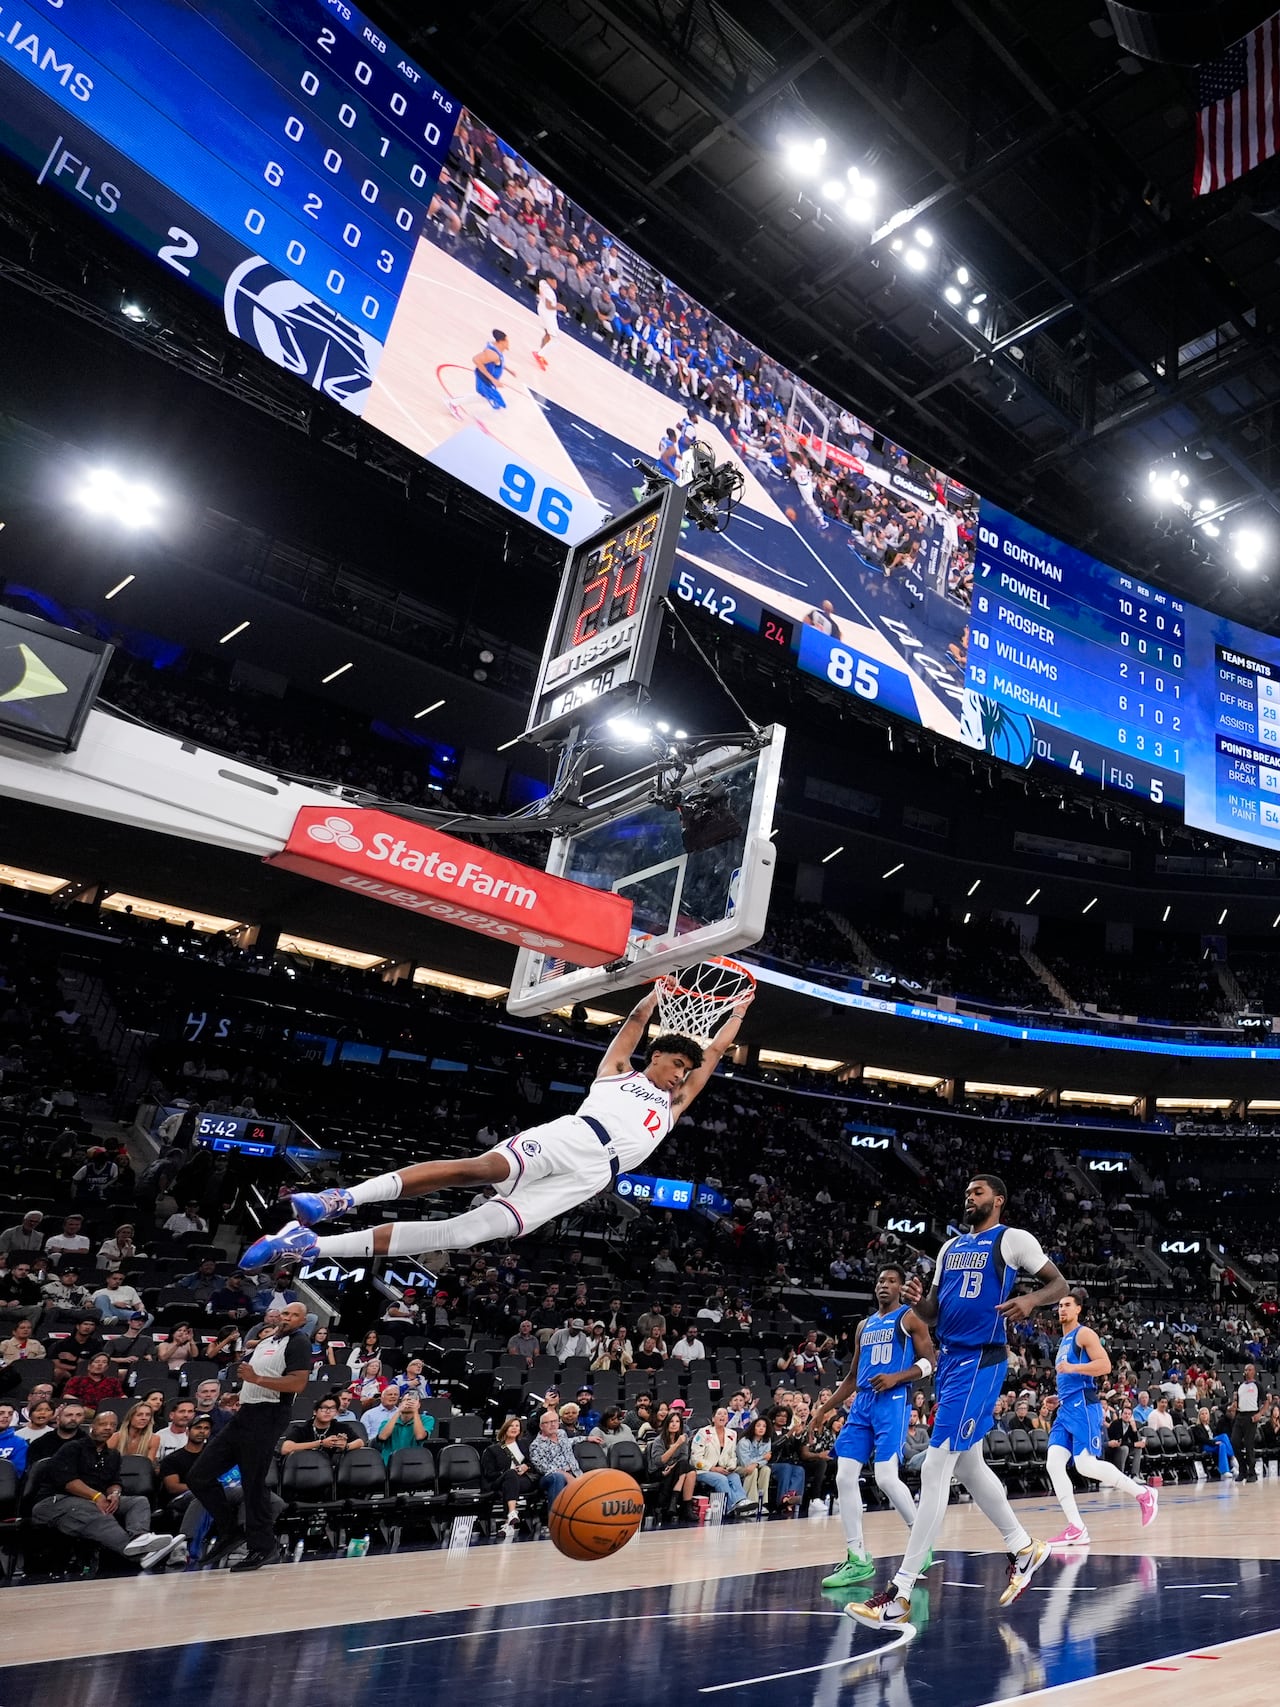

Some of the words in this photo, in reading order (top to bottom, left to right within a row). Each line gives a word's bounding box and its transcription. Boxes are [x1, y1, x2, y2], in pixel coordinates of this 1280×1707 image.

[316, 27, 336, 54] 2
[354, 61, 373, 85] 0
[389, 92, 407, 116] 0
[424, 122, 441, 146] 0
[363, 26, 387, 54] REB
[397, 60, 421, 83] AST
[431, 90, 453, 114] FLS
[300, 70, 320, 96] 0
[338, 103, 357, 129] 0
[380, 136, 390, 158] 1
[409, 164, 427, 188] 0
[284, 116, 305, 142] 0
[323, 148, 343, 174] 0
[360, 179, 379, 204] 0
[395, 207, 414, 232] 0
[53, 150, 121, 213] FLS
[157, 226, 199, 277] 2
[263, 161, 284, 187] 6
[303, 192, 323, 220] 2
[342, 223, 362, 248] 0
[376, 249, 395, 274] 3
[244, 208, 266, 235] 0
[286, 239, 306, 266] 0
[326, 269, 345, 295] 0
[361, 295, 380, 320] 0
[498, 463, 573, 535] 96
[894, 475, 929, 499] Globant
[598, 514, 660, 575] 5:42
[978, 526, 999, 549] 00
[1003, 540, 1063, 583] GORTMAN
[573, 555, 645, 646] 24
[981, 562, 991, 578] 7
[1000, 572, 1051, 611] POWELL
[1120, 577, 1132, 589] PTS
[1137, 585, 1150, 597] REB
[1154, 594, 1166, 605] AST
[1171, 601, 1184, 613] FLS
[677, 571, 737, 625] 5:42
[764, 621, 785, 645] 24
[827, 647, 879, 700] 85
[978, 596, 989, 613] 8
[998, 605, 1055, 646] PROSPER
[1118, 599, 1133, 616] 10
[1139, 608, 1147, 623] 2
[1156, 615, 1165, 630] 0
[1173, 623, 1182, 638] 4
[570, 622, 637, 671] TISSOT
[972, 629, 990, 650] 10
[996, 639, 1058, 681] WILLIAMS
[1221, 650, 1246, 668] TEAM
[1245, 659, 1271, 677] STATS
[969, 665, 986, 685] 13
[993, 675, 1061, 718] MARSHALL
[1219, 669, 1236, 682] OFF
[1237, 675, 1254, 689] REB
[1219, 691, 1236, 705] DEF
[1237, 698, 1254, 712] REB
[1263, 706, 1277, 720] 29
[1219, 714, 1255, 734] ASSISTS
[1263, 728, 1277, 742] 28
[1069, 750, 1084, 776] 4
[1221, 740, 1253, 759] POINTS
[1110, 767, 1134, 790] FLS
[1150, 778, 1164, 804] 5
[1228, 769, 1257, 787] BREAK
[1234, 759, 1257, 775] FAST
[1265, 775, 1277, 788] 31
[1228, 794, 1238, 806] IN
[1238, 796, 1258, 811] THE
[1231, 806, 1257, 822] PAINT
[1265, 810, 1279, 824] 54
[366, 833, 458, 882] State
[457, 862, 537, 911] Farm
[339, 876, 431, 909] Farm
[430, 905, 518, 936] State
[620, 1082, 669, 1109] Clippers
[200, 1119, 237, 1137] 5:42
[252, 1128, 265, 1138] 24
[643, 1108, 661, 1138] 12
[633, 1185, 650, 1198] 96
[672, 1189, 688, 1203] 85
[945, 1252, 988, 1270] DALLAS
[960, 1272, 983, 1298] 13
[861, 1328, 894, 1345] DALLAS
[871, 1343, 892, 1365] 00
